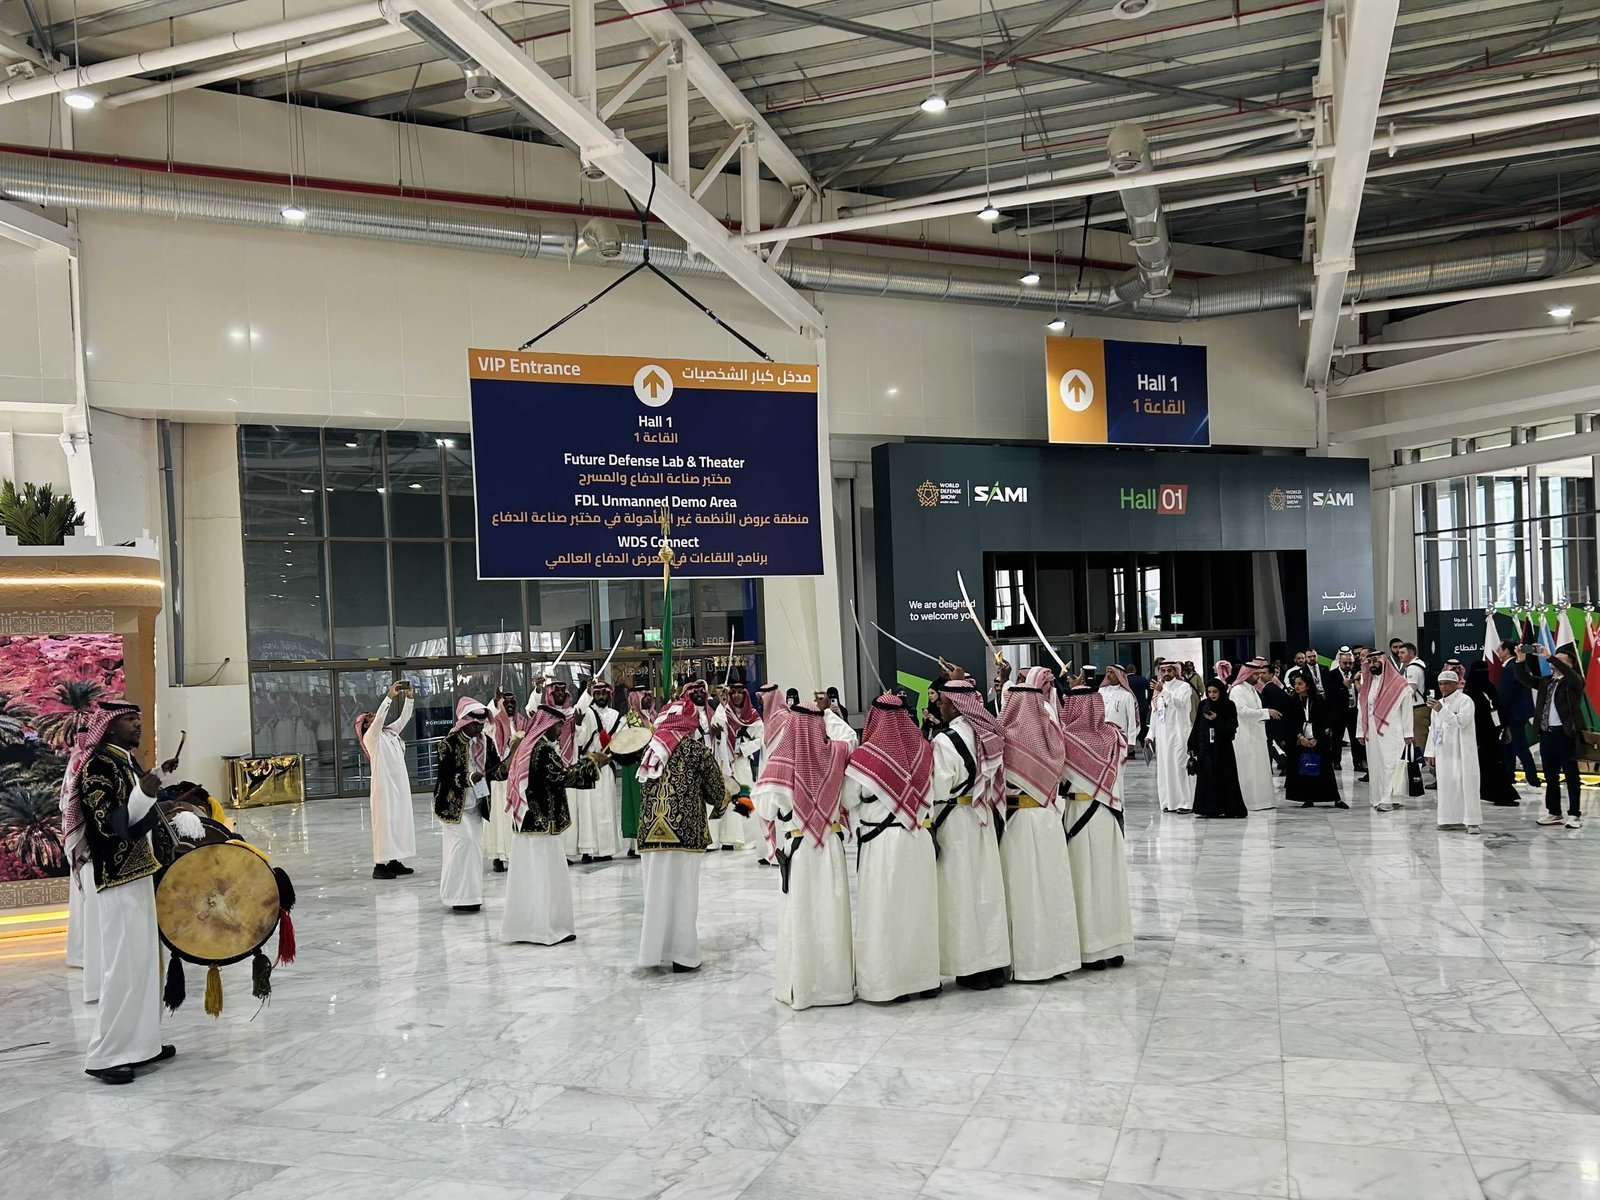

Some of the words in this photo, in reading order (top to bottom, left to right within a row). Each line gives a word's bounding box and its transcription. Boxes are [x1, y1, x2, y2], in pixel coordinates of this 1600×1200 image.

[477, 356, 506, 372] VIP
[510, 358, 581, 376] Entrance
[682, 366, 748, 382] الشخصيات
[750, 369, 774, 385] كبار
[777, 369, 812, 386] مدخل
[1137, 373, 1166, 391] Hall
[1170, 376, 1178, 392] 1
[1132, 398, 1140, 413] 1
[1144, 398, 1186, 415] القاعة
[638, 415, 663, 428] Hall
[665, 416, 673, 428] 1
[633, 432, 640, 443] 1
[643, 431, 678, 443] القاعة
[563, 452, 606, 466] Future
[608, 453, 660, 467] Defense
[662, 455, 684, 468] Lab
[686, 455, 697, 468] &
[698, 455, 746, 469] Theater
[578, 471, 627, 486] والمسرح
[630, 471, 663, 487] الدفاع
[666, 472, 700, 484] صناعة
[702, 473, 732, 487] مختبر
[974, 482, 1028, 505] SAMI
[1120, 487, 1157, 510] Hall
[1162, 488, 1183, 510] 01
[574, 494, 600, 506] FDL
[601, 494, 669, 508] Unmanned
[671, 495, 707, 508] Demo
[709, 496, 738, 508] Area
[491, 511, 528, 526] الدفاع
[531, 511, 567, 523] صناعة
[569, 512, 601, 526] مختبر
[604, 512, 621, 529] في
[624, 509, 674, 527] اأهولة
[675, 513, 692, 527] غير
[695, 511, 736, 524] الأنظمة
[739, 513, 771, 527] عروض
[773, 513, 809, 524] منطقة
[617, 535, 648, 548] WDS
[650, 535, 700, 548] Connect
[545, 552, 592, 570] العالمي
[594, 552, 629, 567] الدفاع
[632, 554, 666, 567] عرض
[689, 552, 734, 563] اللقاءات
[737, 552, 768, 566] برنامج
[1321, 589, 1357, 599] نسعد
[908, 600, 923, 609] We
[924, 601, 937, 609] are
[938, 599, 976, 611] delightd
[1322, 601, 1357, 615] بزيارتكم
[909, 612, 919, 621] to
[920, 611, 959, 621] welcome
[960, 612, 974, 622] yo
